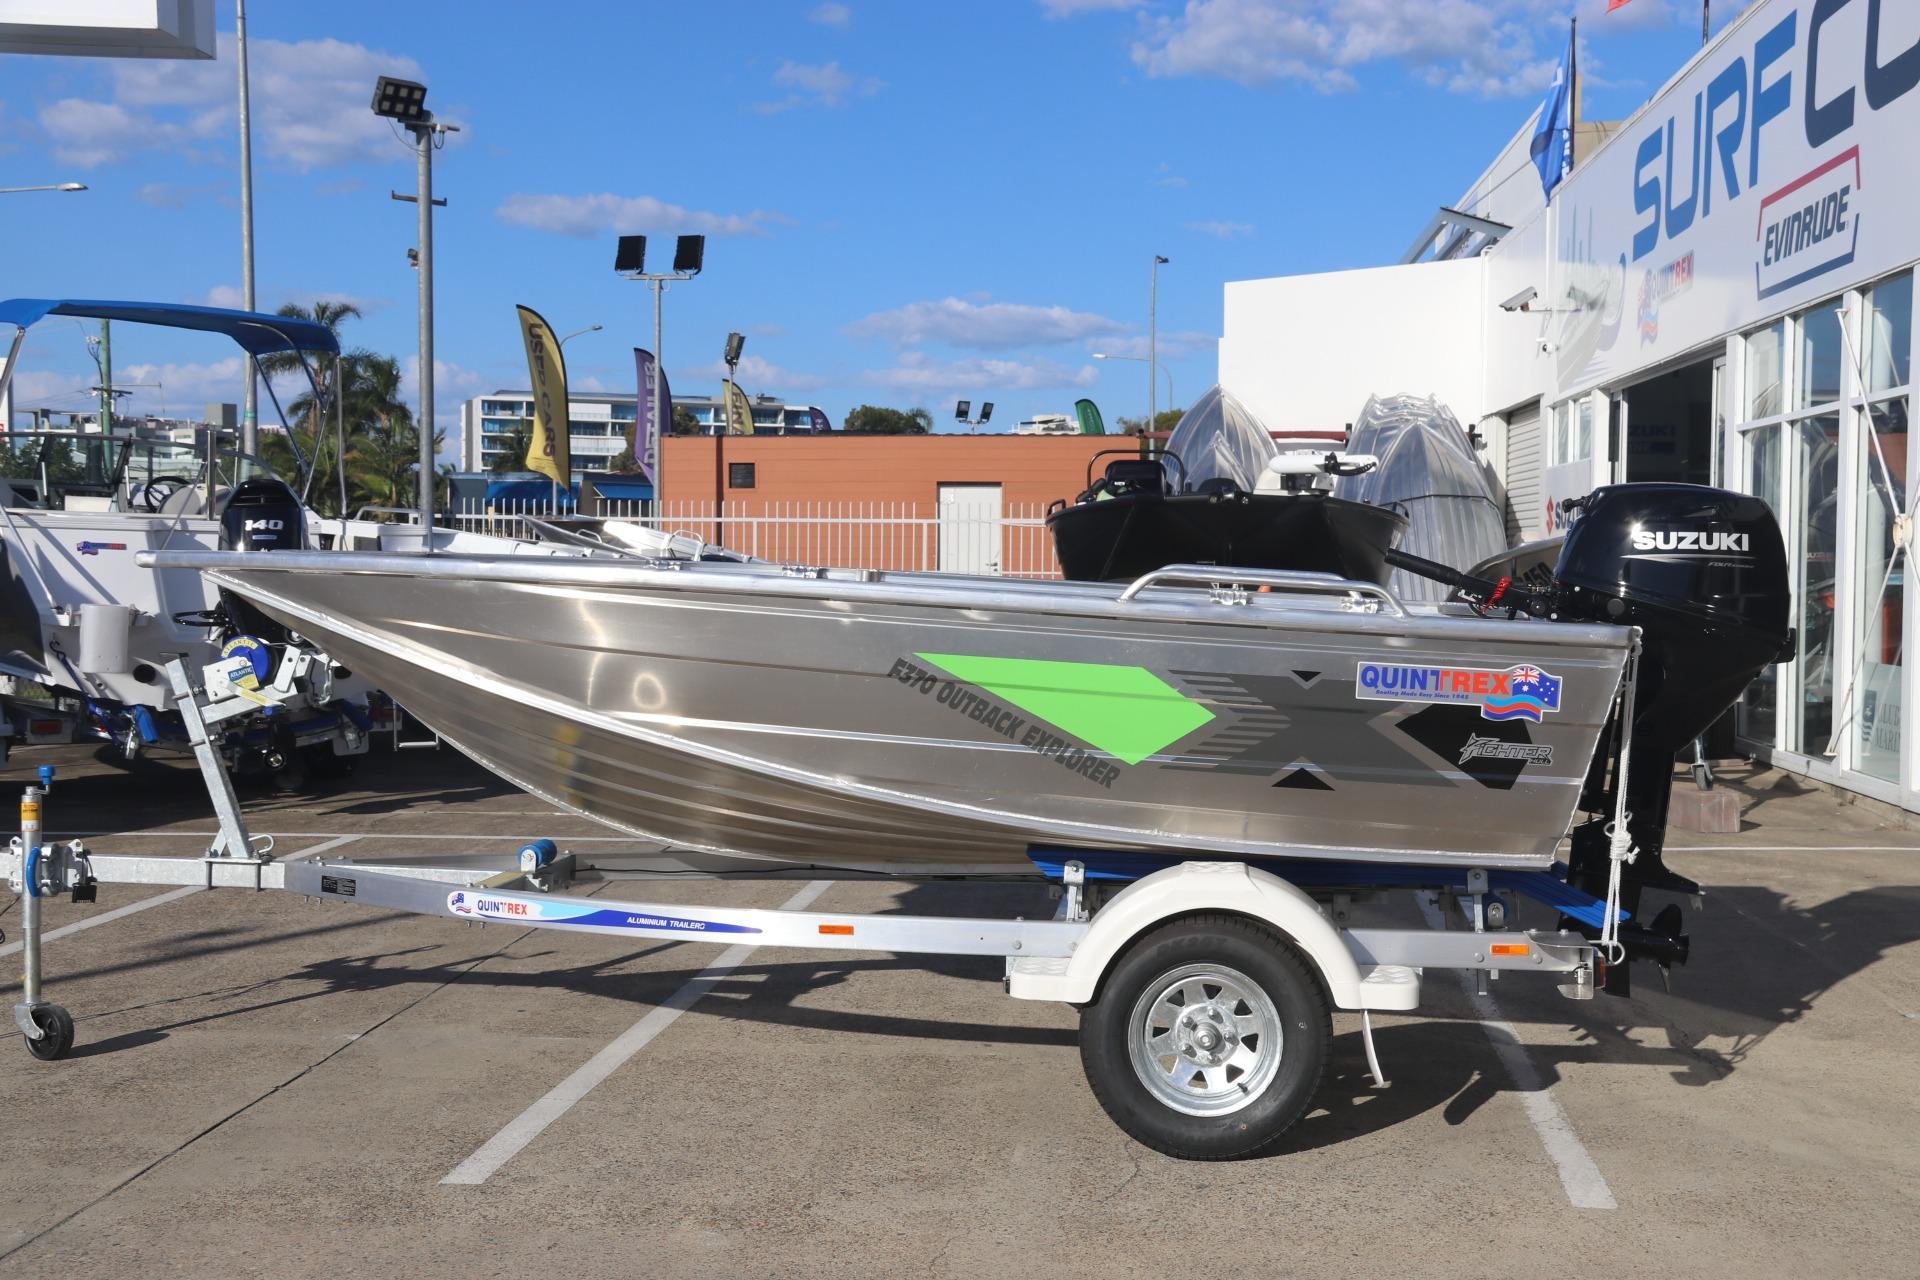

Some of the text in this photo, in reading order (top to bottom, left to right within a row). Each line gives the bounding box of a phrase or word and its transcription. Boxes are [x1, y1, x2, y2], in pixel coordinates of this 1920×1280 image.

[1763, 184, 1850, 267] EVINRUDE
[542, 391, 556, 457] CARS
[245, 519, 284, 531] 140
[1632, 530, 1750, 551] SUZUKI
[223, 639, 256, 656] ATLANTIC
[230, 666, 254, 679] ATLANTIC
[1361, 666, 1511, 695] QUINTREX
[886, 657, 1121, 789] F370 OUTBACK EXPLORER
[1459, 732, 1553, 764] FIGHTER
[477, 899, 528, 915] QUINTREX
[626, 916, 706, 930] ALUMINIUM TRAILERS
